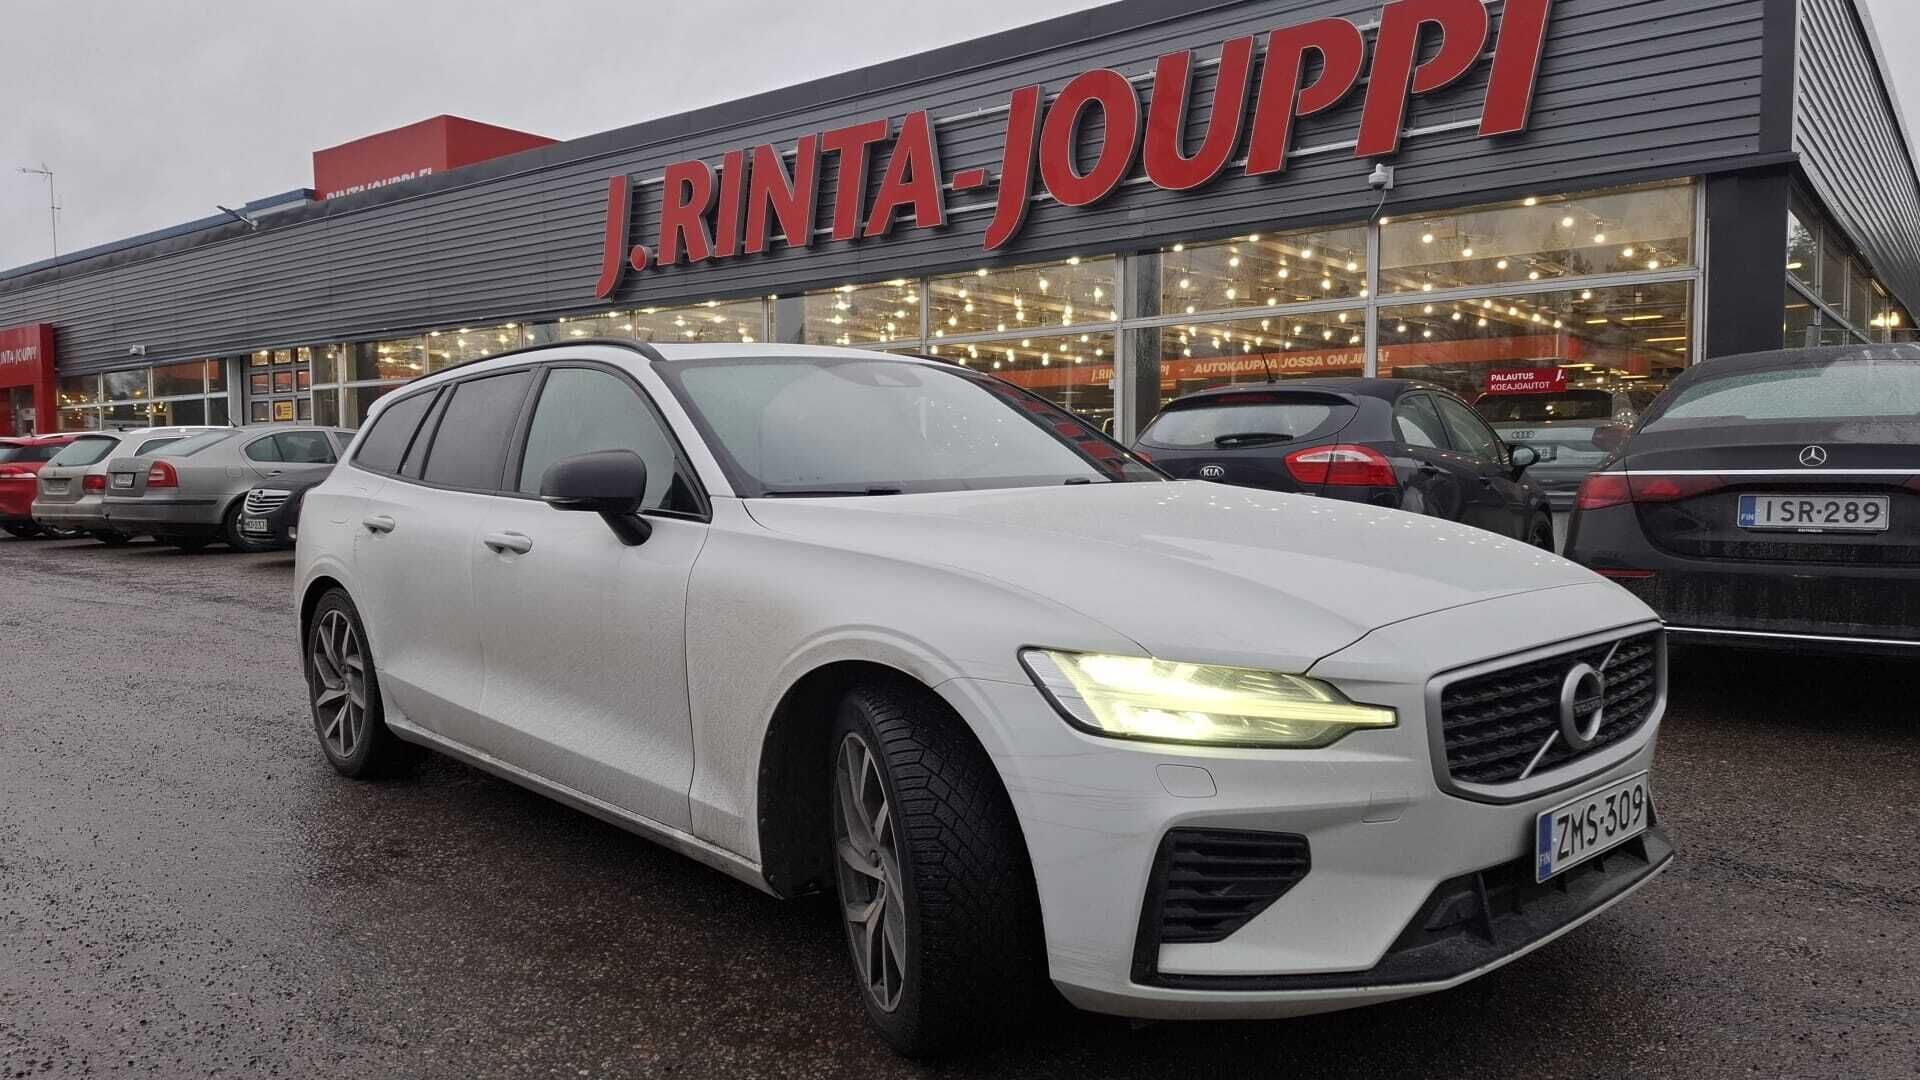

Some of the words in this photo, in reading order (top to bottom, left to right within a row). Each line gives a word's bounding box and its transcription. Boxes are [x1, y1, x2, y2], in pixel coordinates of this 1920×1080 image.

[595, 0, 1551, 299] J.RINTA-JOUPPI
[1194, 358, 1278, 373] AUTOKAUPPA
[1280, 356, 1323, 369] JOSSA
[1327, 353, 1348, 365] ON
[1491, 372, 1534, 381] PALAUTUS
[1491, 381, 1550, 391] KOEAJOAUTOT
[1203, 468, 1220, 477] KIA
[1766, 500, 1880, 523] ISR-289
[1557, 784, 1643, 861] ZMS-309
